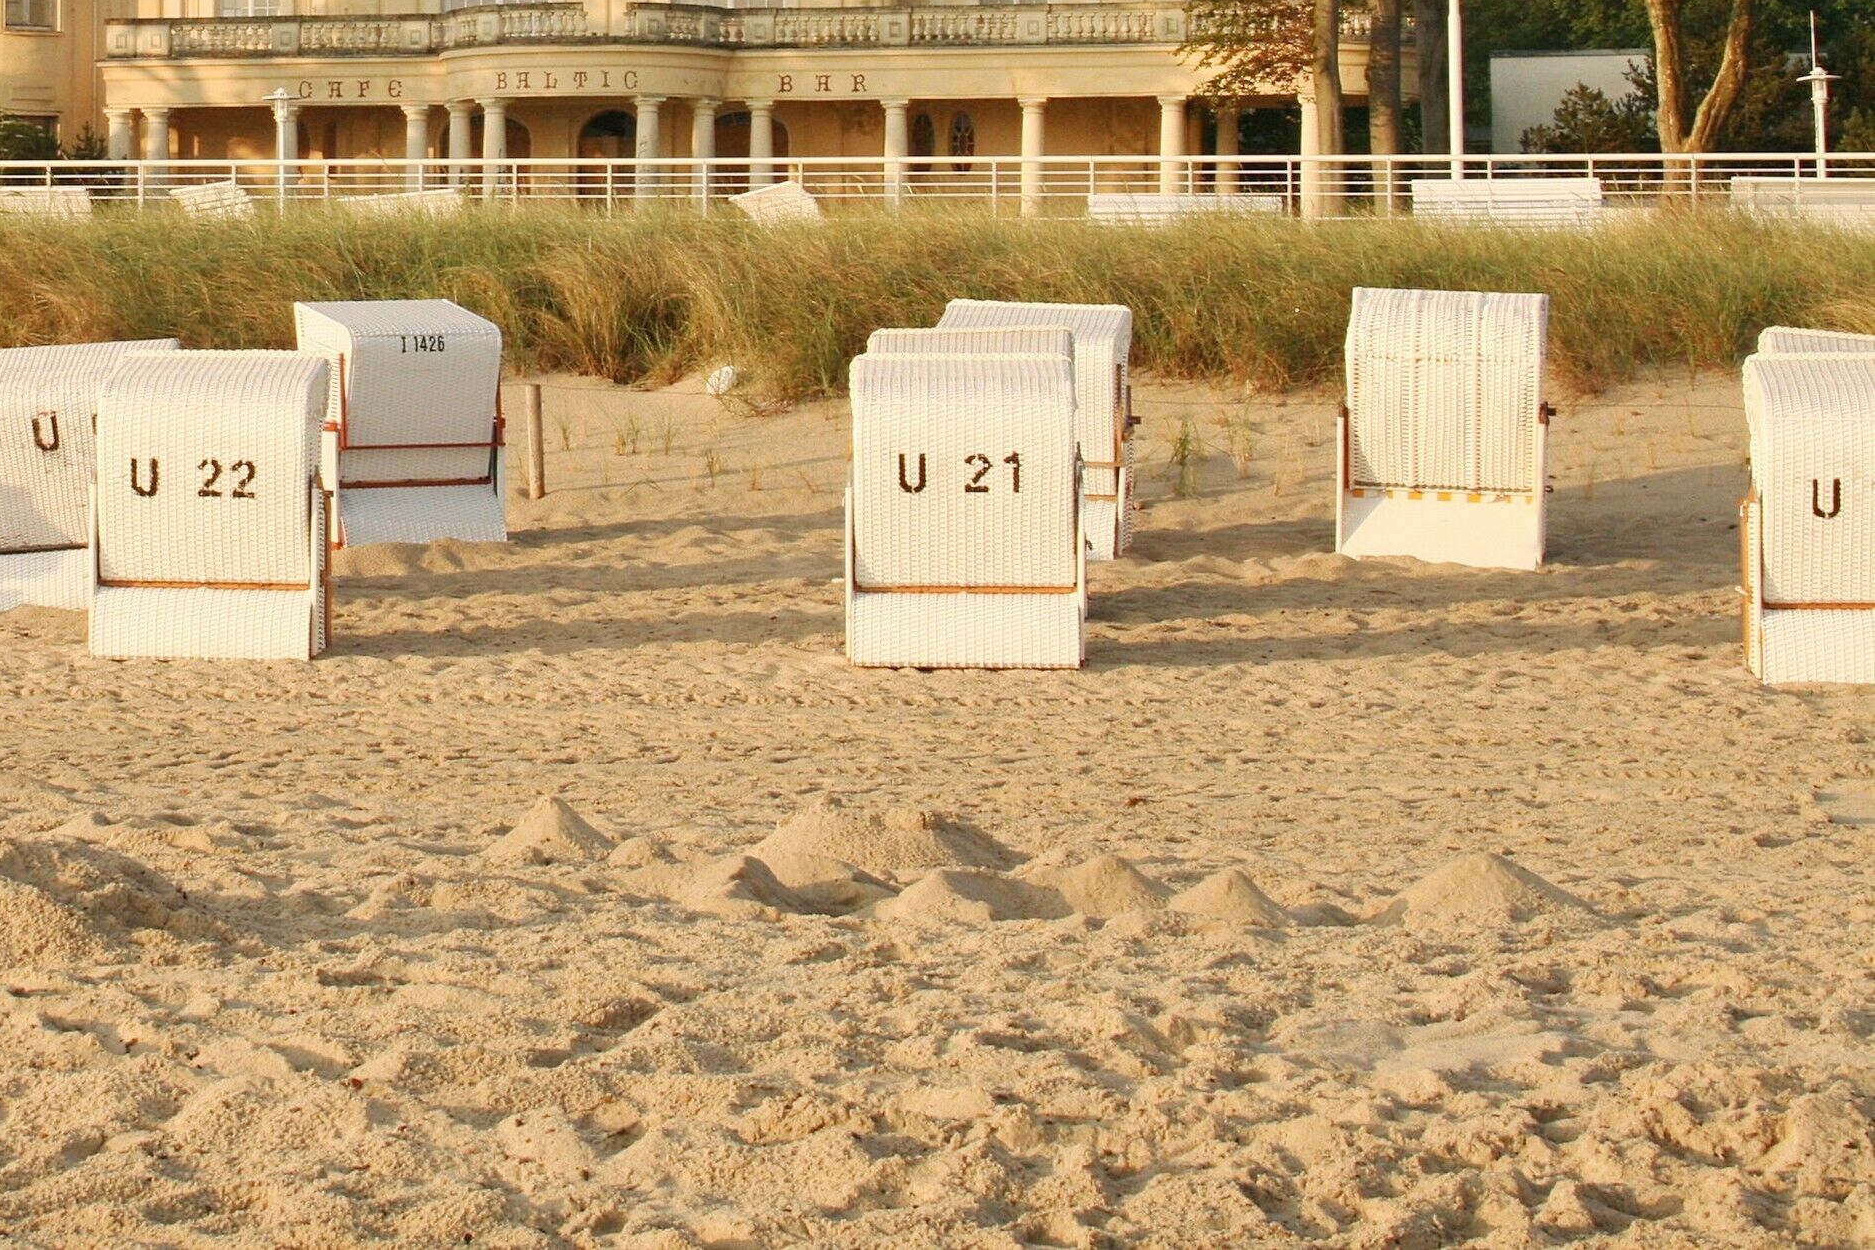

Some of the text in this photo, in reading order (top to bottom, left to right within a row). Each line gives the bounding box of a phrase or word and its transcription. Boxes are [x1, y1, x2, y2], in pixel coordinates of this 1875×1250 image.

[298, 70, 868, 100] CAFE BALTIC BAR
[413, 334, 445, 353] 1426
[31, 410, 60, 452] U
[130, 457, 256, 499] U 22
[898, 450, 1022, 494] U 21
[1812, 477, 1842, 519] U
